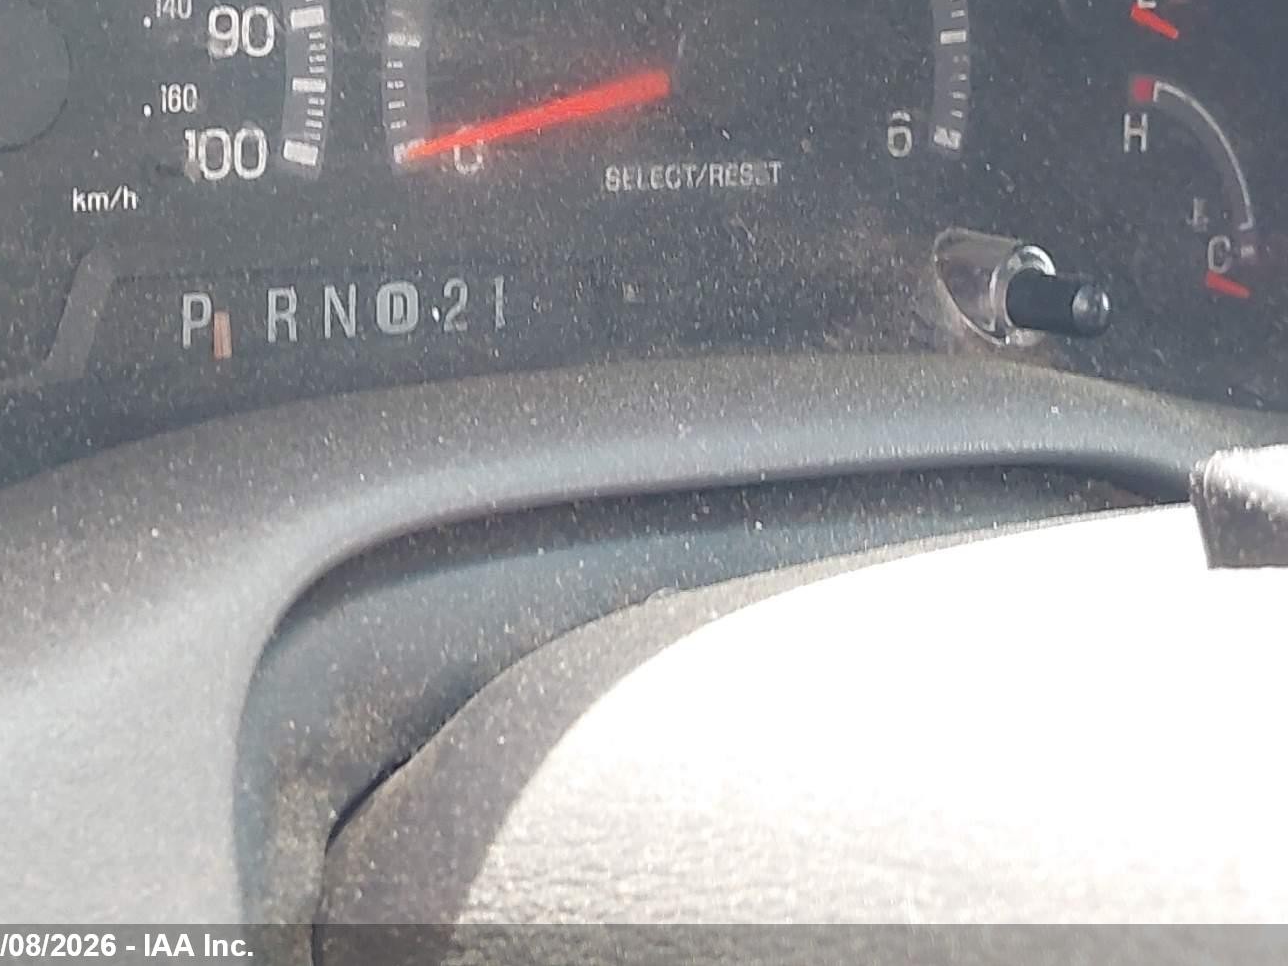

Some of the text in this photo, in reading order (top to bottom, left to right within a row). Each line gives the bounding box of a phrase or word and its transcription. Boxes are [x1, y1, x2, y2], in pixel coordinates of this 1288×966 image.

[207, 4, 275, 58] 90
[160, 83, 197, 113] 160
[184, 127, 267, 181] 100
[886, 109, 913, 157] 6
[1123, 113, 1148, 153] H
[72, 186, 139, 212] km/h
[181, 291, 212, 349] P
[266, 286, 298, 342] R
[323, 283, 357, 338] N
[376, 280, 419, 334] D
[442, 277, 469, 332] 2
